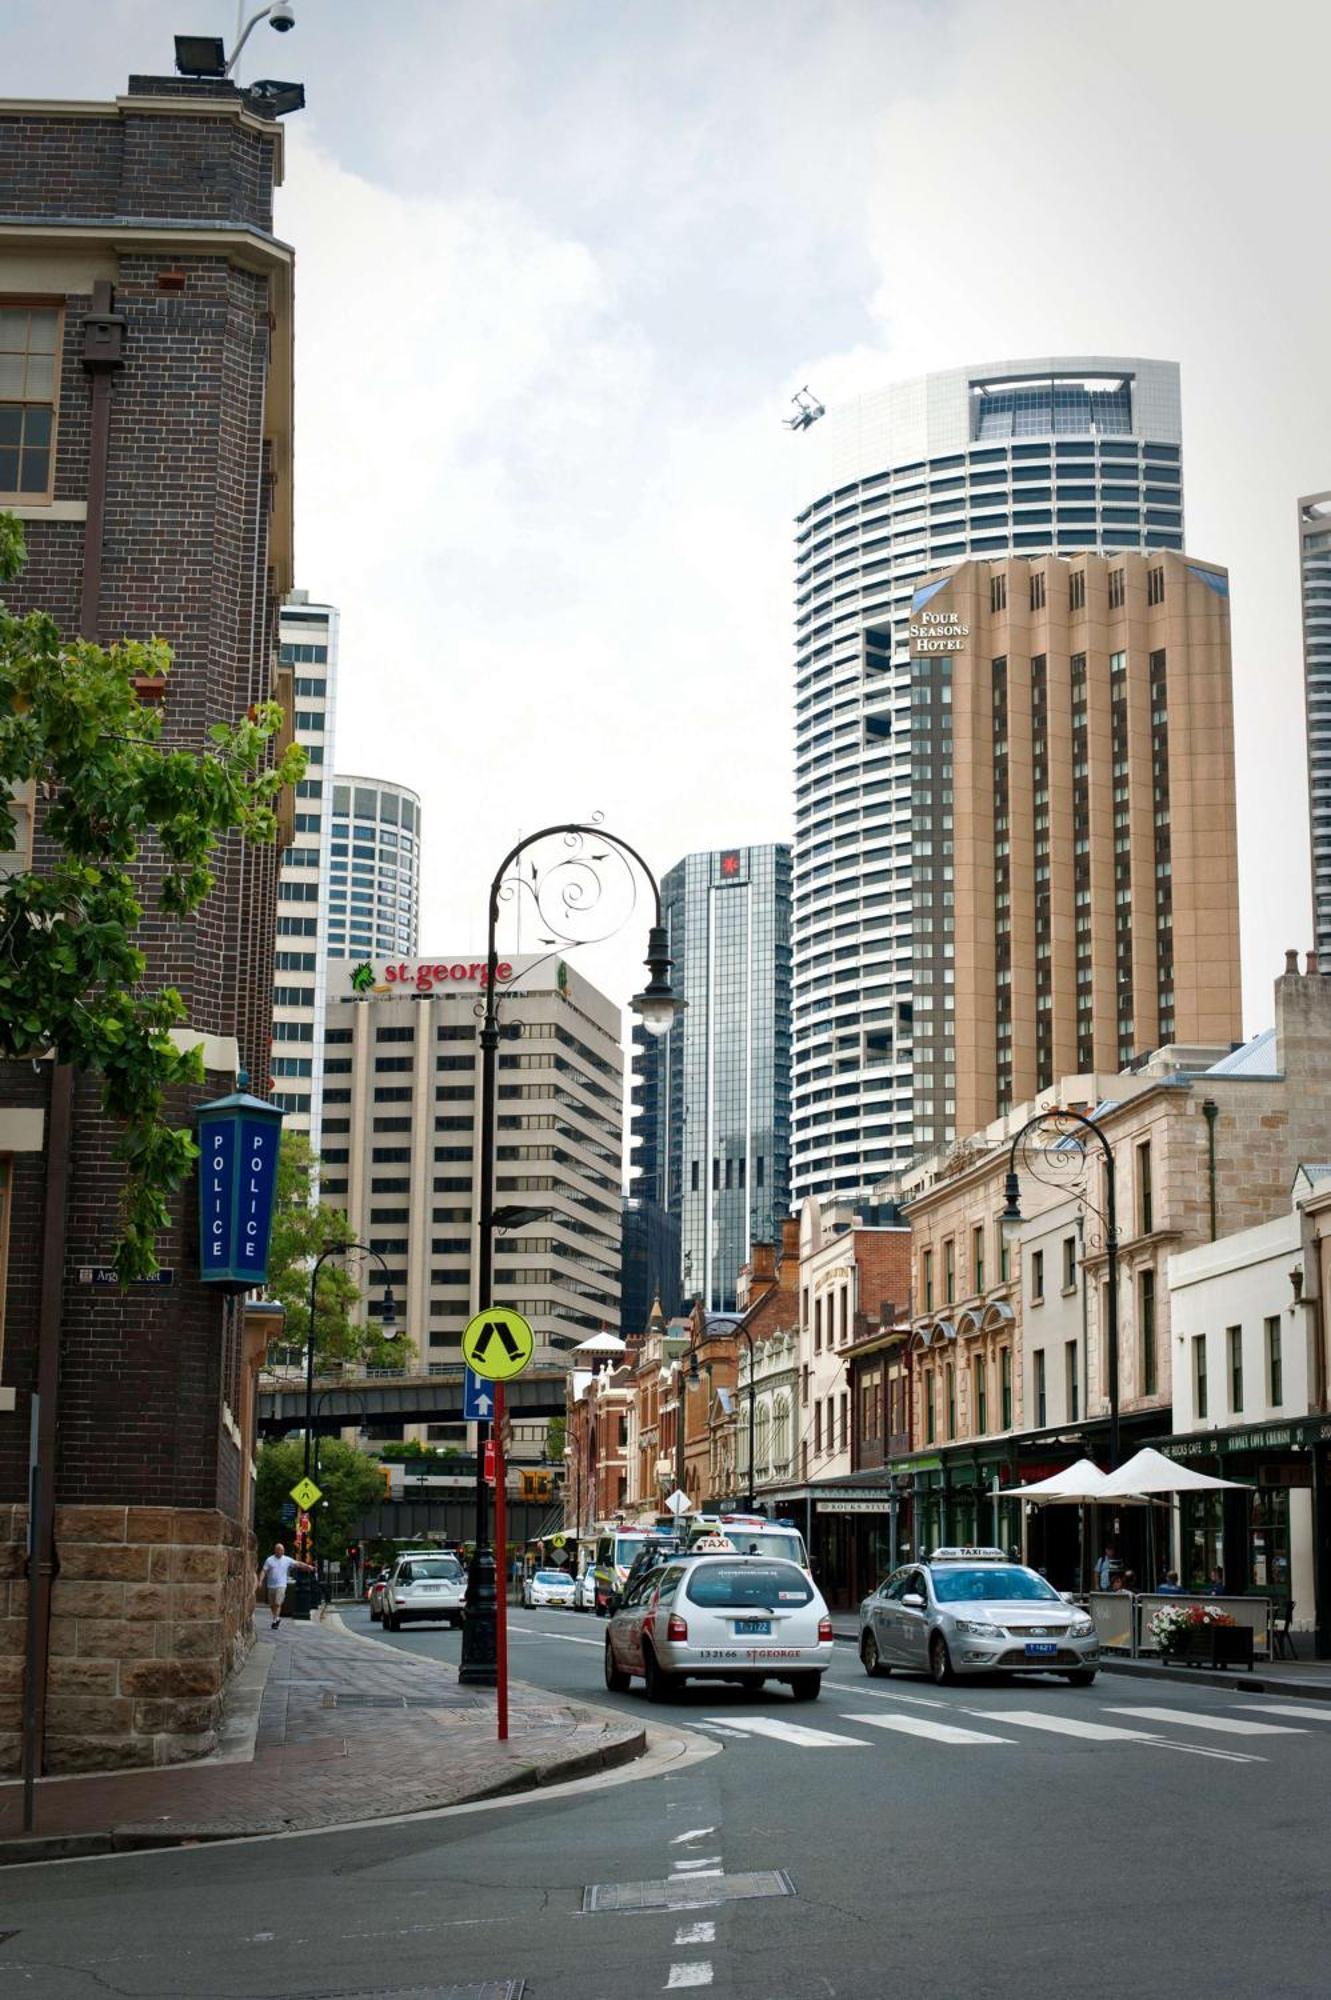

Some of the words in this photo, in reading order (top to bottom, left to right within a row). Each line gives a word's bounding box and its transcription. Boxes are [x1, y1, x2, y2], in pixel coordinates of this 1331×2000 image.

[922, 611, 958, 625] FOUR
[910, 624, 969, 637] SEASONS
[917, 639, 965, 652] HOTEL
[212, 1135, 224, 1256] POLICE
[245, 1136, 263, 1257] POLICE
[703, 1540, 729, 1548] TAXI
[960, 1548, 981, 1556] TAXI
[759, 1650, 801, 1658] GEORGE
